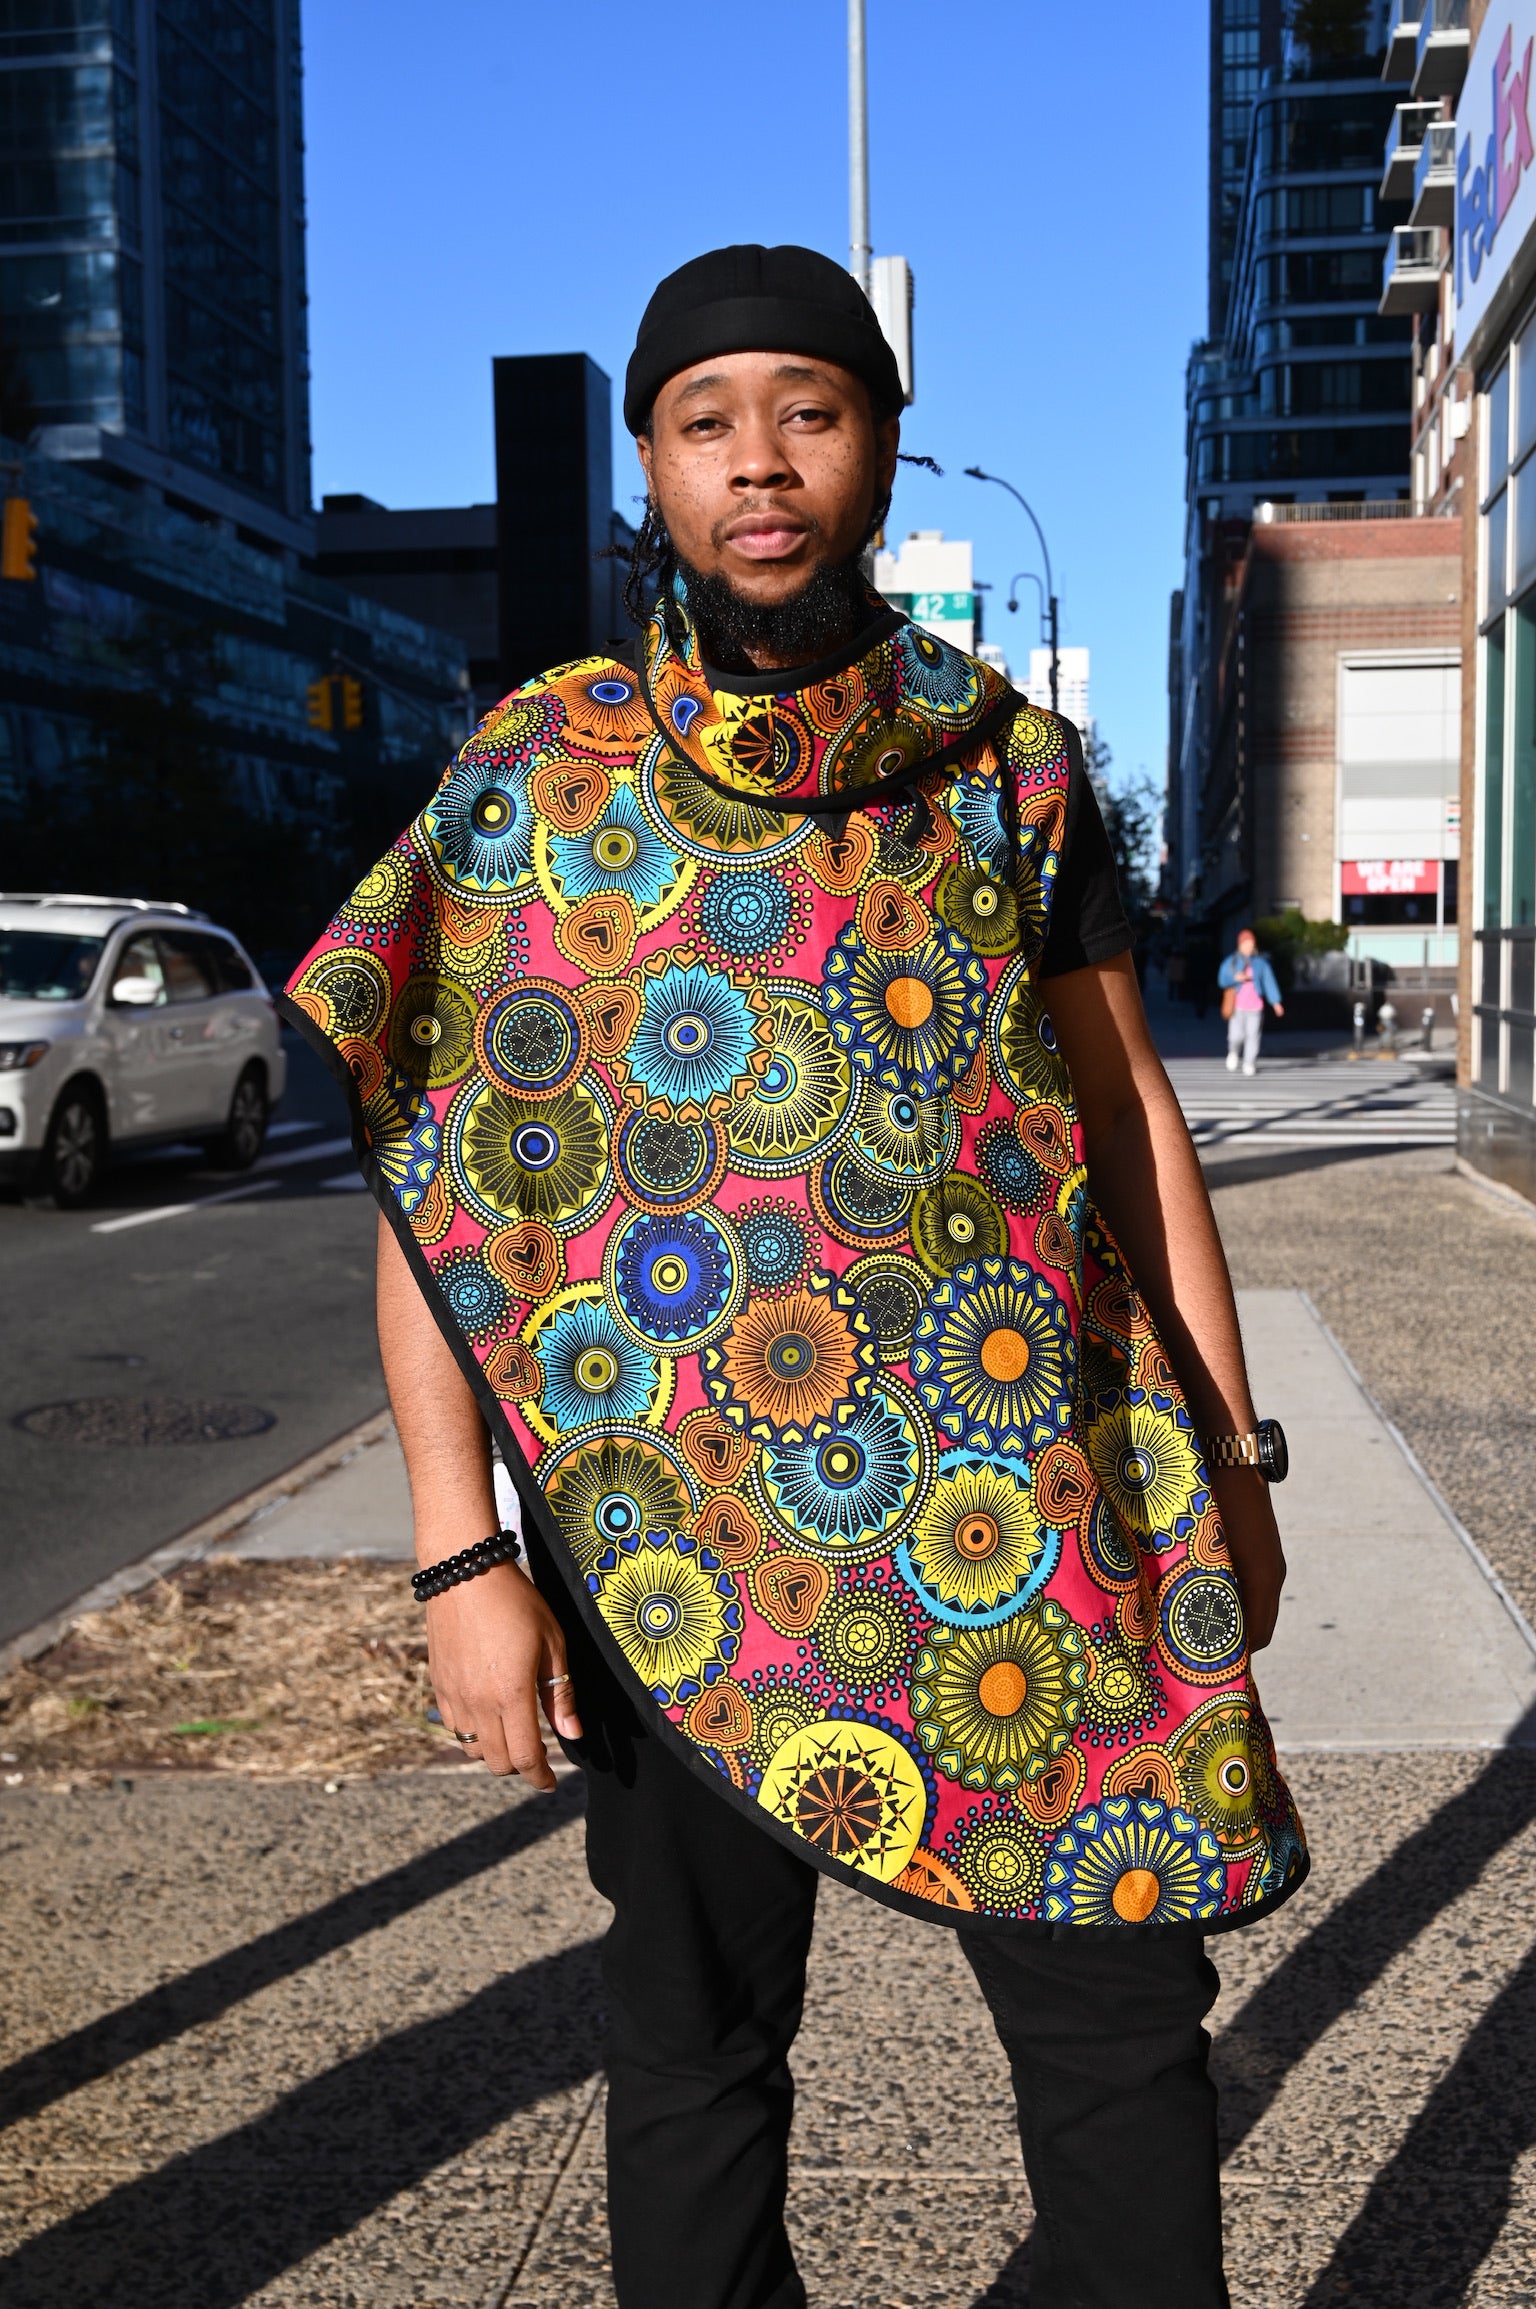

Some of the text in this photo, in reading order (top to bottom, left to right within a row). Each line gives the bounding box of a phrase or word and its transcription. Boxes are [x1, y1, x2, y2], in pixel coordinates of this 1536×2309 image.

[1457, 23, 1534, 310] FedEx
[912, 594, 945, 620] 42
[1356, 861, 1425, 878] WE ARE
[1366, 876, 1416, 893] OPEN
